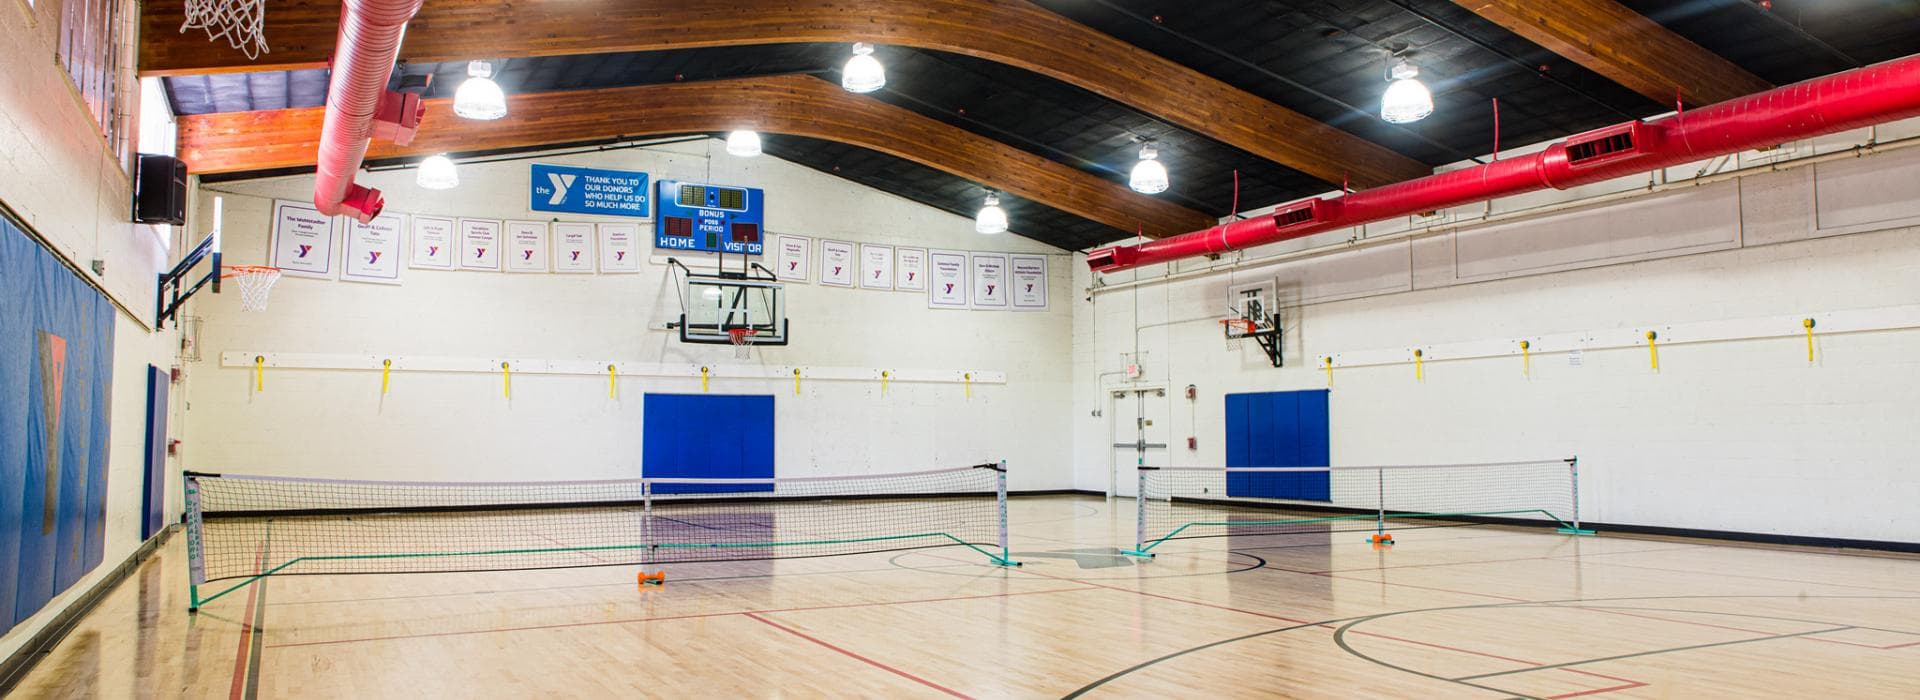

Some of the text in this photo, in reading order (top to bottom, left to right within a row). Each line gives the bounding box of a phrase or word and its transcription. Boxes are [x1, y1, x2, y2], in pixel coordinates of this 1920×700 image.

[584, 175, 639, 186] THANK YOU TO
[536, 187, 550, 195] the
[584, 184, 633, 194] OUR DONORS
[584, 192, 603, 200] WHO
[635, 195, 645, 203] DO
[596, 201, 618, 209] MUCH
[620, 202, 641, 211] MORE
[698, 210, 725, 218] BONUS
[699, 224, 724, 232] PERIOD
[660, 237, 696, 248] HOME
